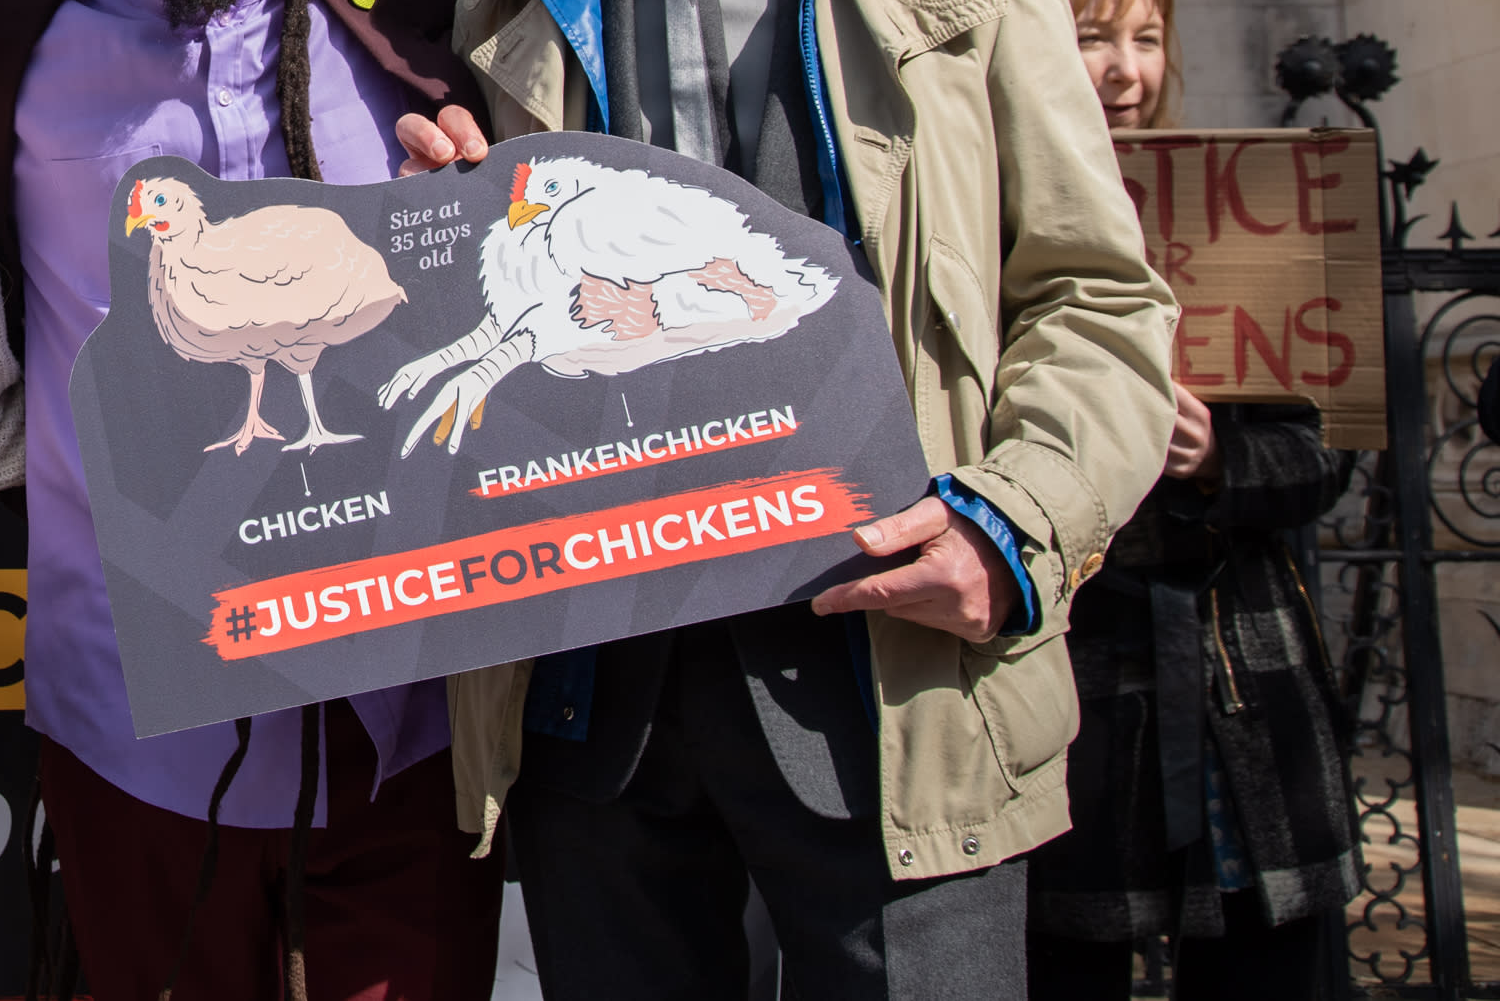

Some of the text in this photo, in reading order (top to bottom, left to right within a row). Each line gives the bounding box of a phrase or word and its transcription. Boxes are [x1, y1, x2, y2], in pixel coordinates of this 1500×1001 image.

[390, 200, 462, 230] Size at
[390, 223, 471, 253] 35 days
[419, 246, 454, 270] old
[476, 404, 797, 497] FRANKENCHICKEN
[238, 489, 391, 546] CHICKEN
[225, 483, 826, 643] #JUSTICEFORCHICKENS
